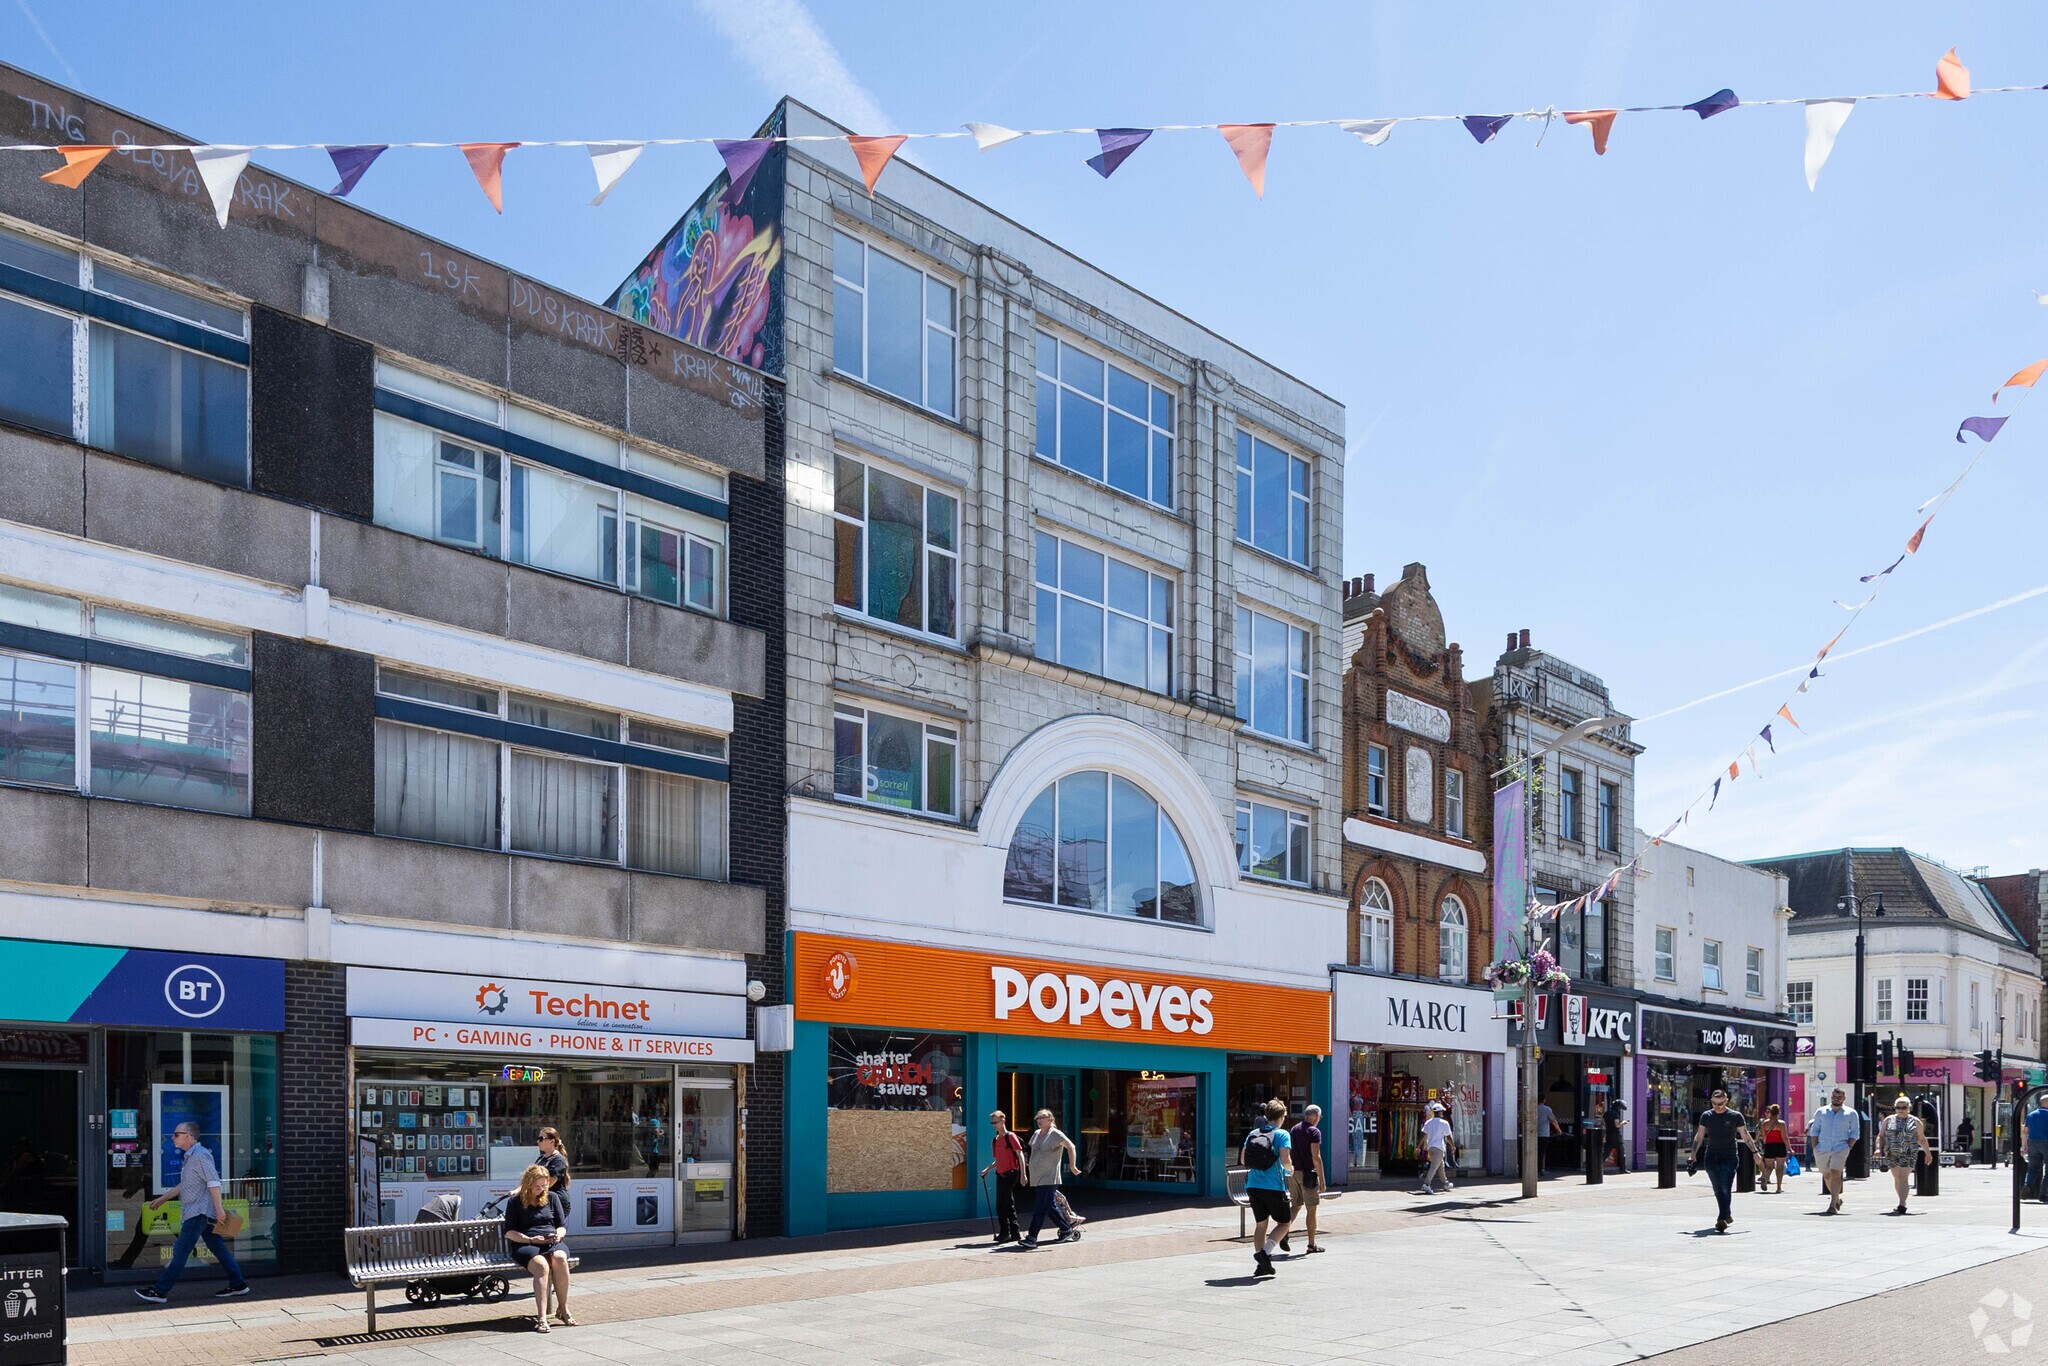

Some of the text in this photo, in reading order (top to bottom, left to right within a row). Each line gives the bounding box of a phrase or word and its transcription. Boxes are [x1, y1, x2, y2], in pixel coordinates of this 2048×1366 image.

[17, 95, 86, 142] TNG
[233, 172, 296, 217] RAK
[673, 349, 722, 384] KRAK
[179, 980, 212, 1001] BT
[529, 990, 650, 1021] Technet
[1387, 996, 1467, 1034] MARCI
[576, 1018, 598, 1028] believe
[1587, 1007, 1632, 1041] KFC
[413, 1026, 714, 1056] PC GAMING PHONE & IT SERVICES
[1702, 1029, 1756, 1049] TACO BELL
[856, 1051, 912, 1067] shatter
[502, 1068, 542, 1082] REPAIR
[878, 1083, 928, 1097] savers
[1347, 1117, 1378, 1133] SALE
[1457, 1120, 1482, 1136] SALE
[4, 1329, 53, 1342] Southend
